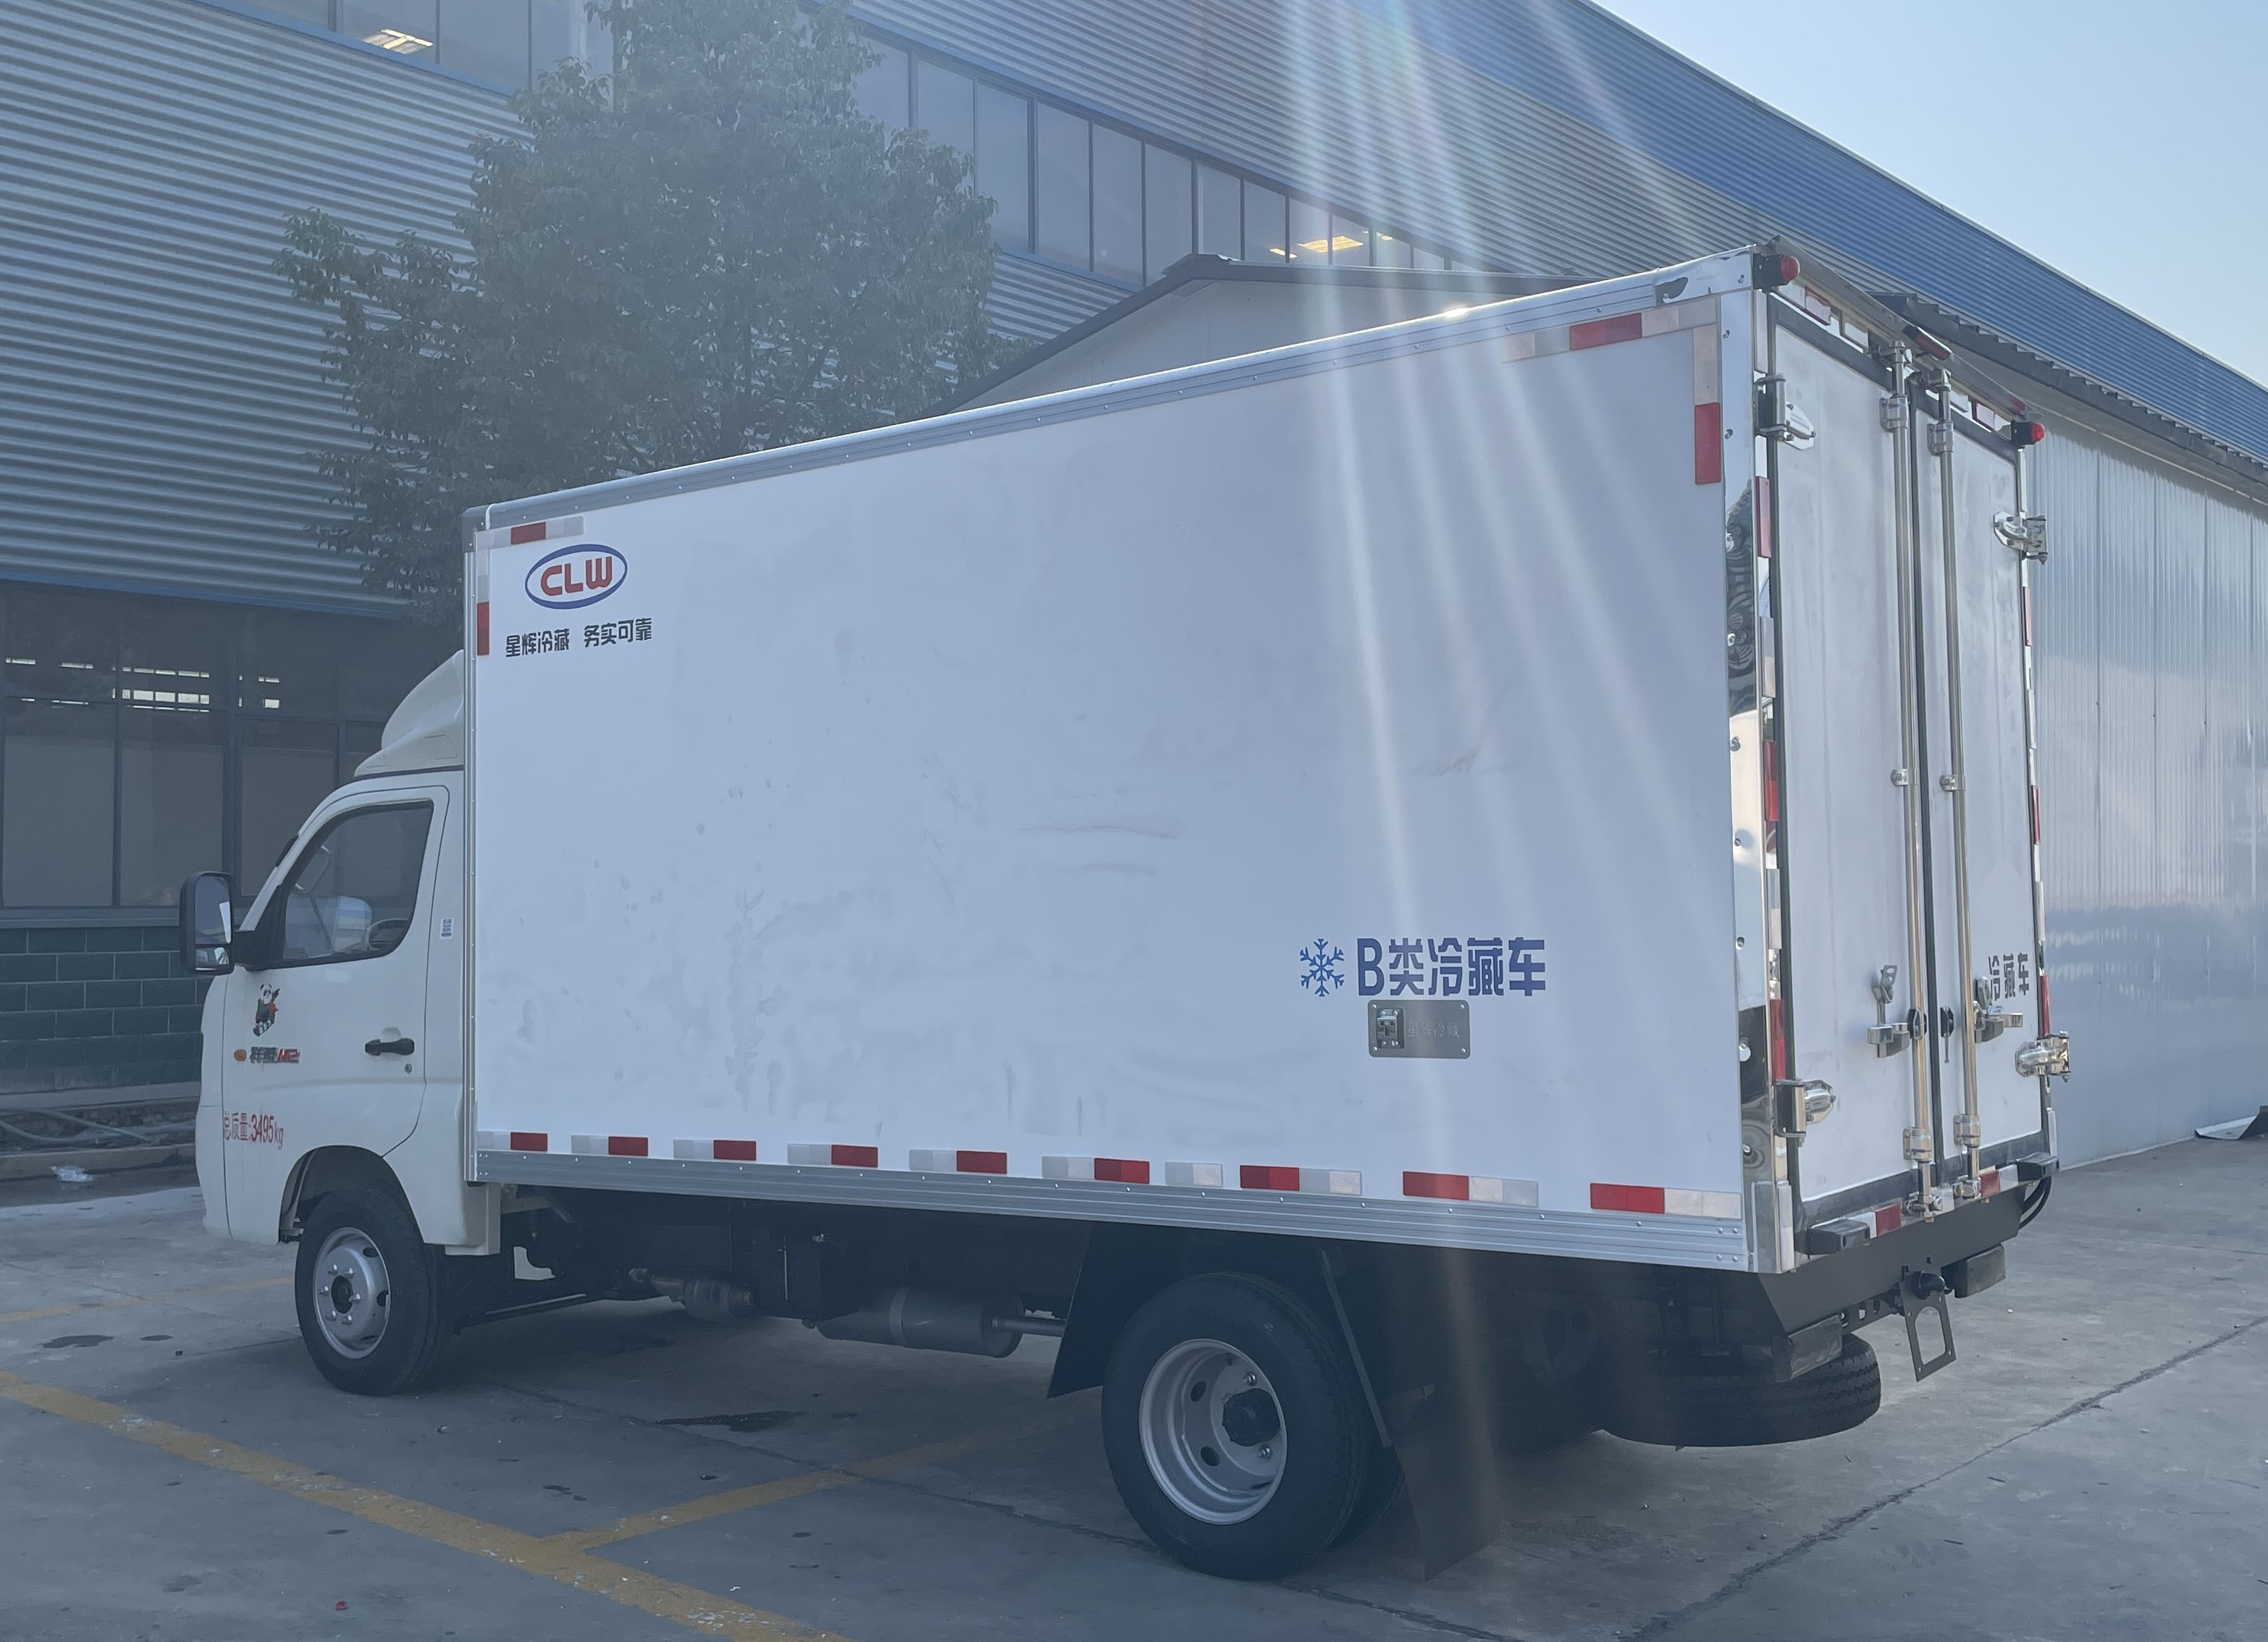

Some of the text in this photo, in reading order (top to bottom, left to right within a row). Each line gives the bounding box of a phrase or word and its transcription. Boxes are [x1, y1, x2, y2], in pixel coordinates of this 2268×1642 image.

[540, 556, 613, 597] CLW
[505, 618, 652, 658] 星辉冷藏 务实可靠
[1356, 937, 1546, 997] B类冷藏车
[1988, 952, 2030, 1001] 冷藏车
